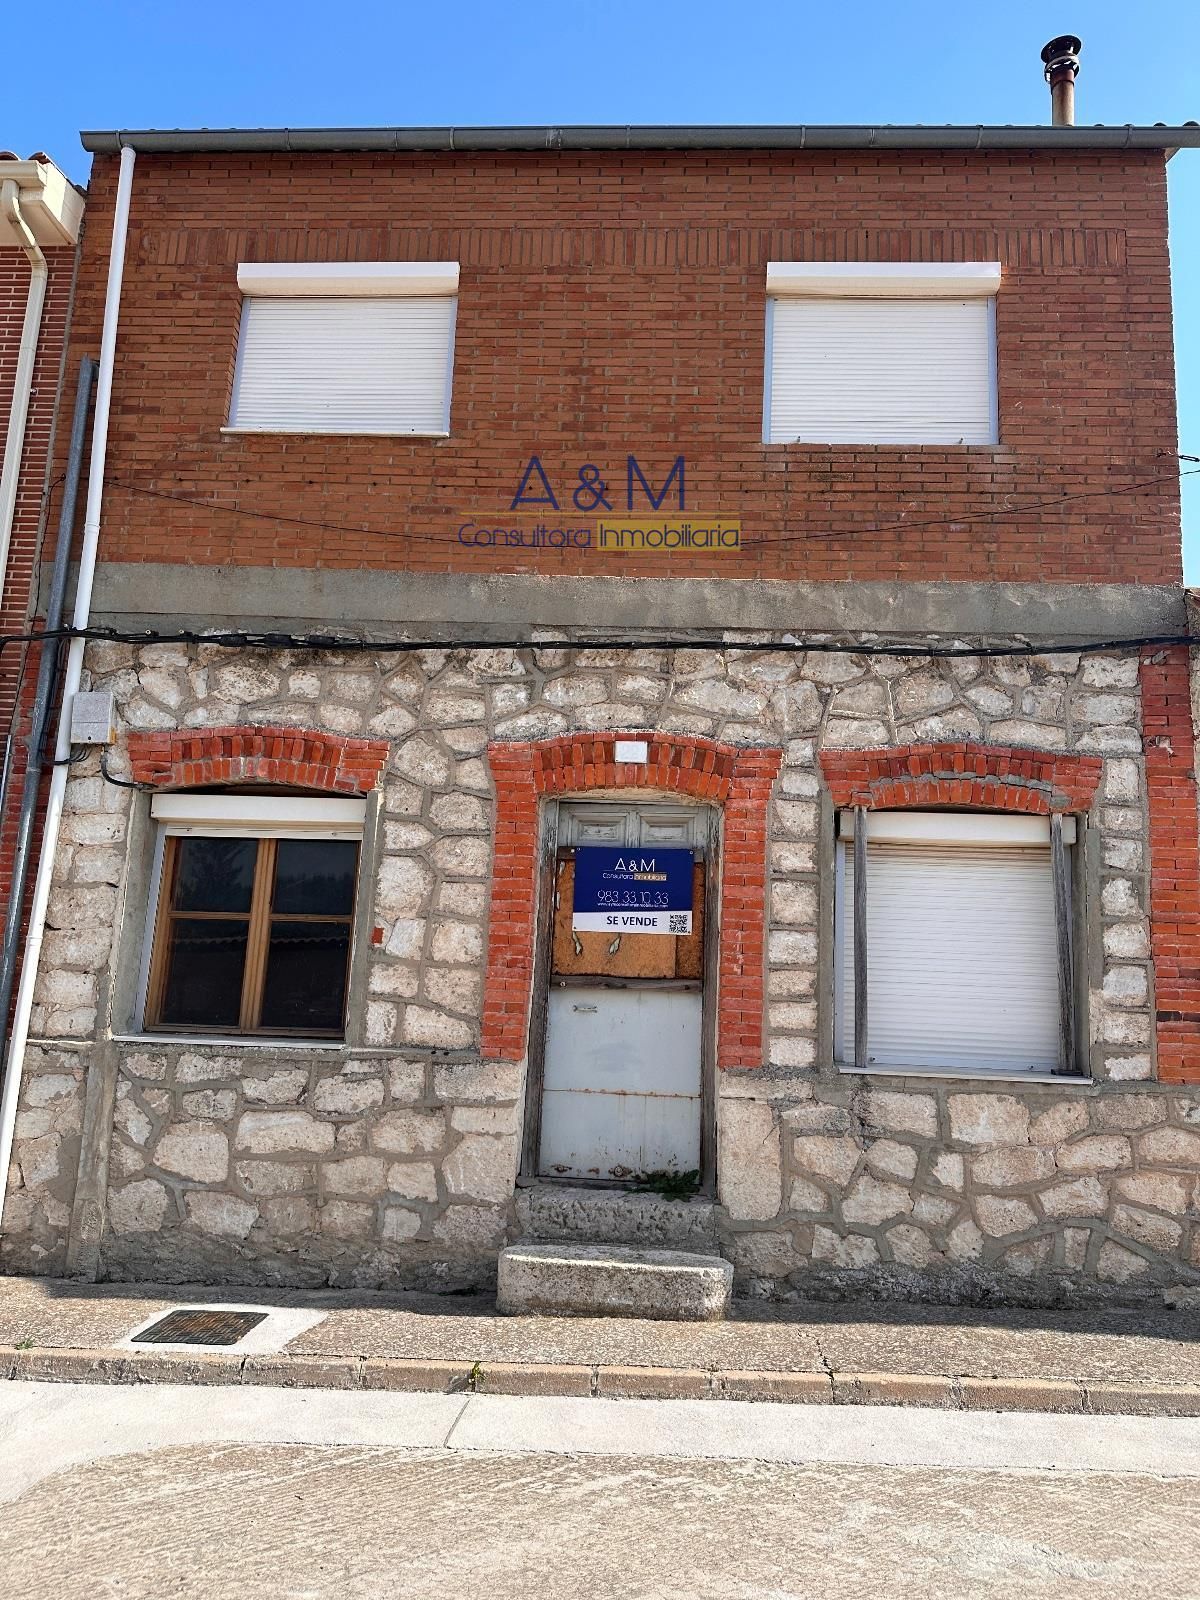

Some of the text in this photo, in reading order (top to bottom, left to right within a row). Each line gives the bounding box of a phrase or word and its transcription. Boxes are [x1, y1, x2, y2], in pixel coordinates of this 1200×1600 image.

[597, 889, 619, 903] 983
[622, 890, 637, 904] 33
[653, 892, 669, 905] 33
[606, 915, 658, 927] SE VENDE
